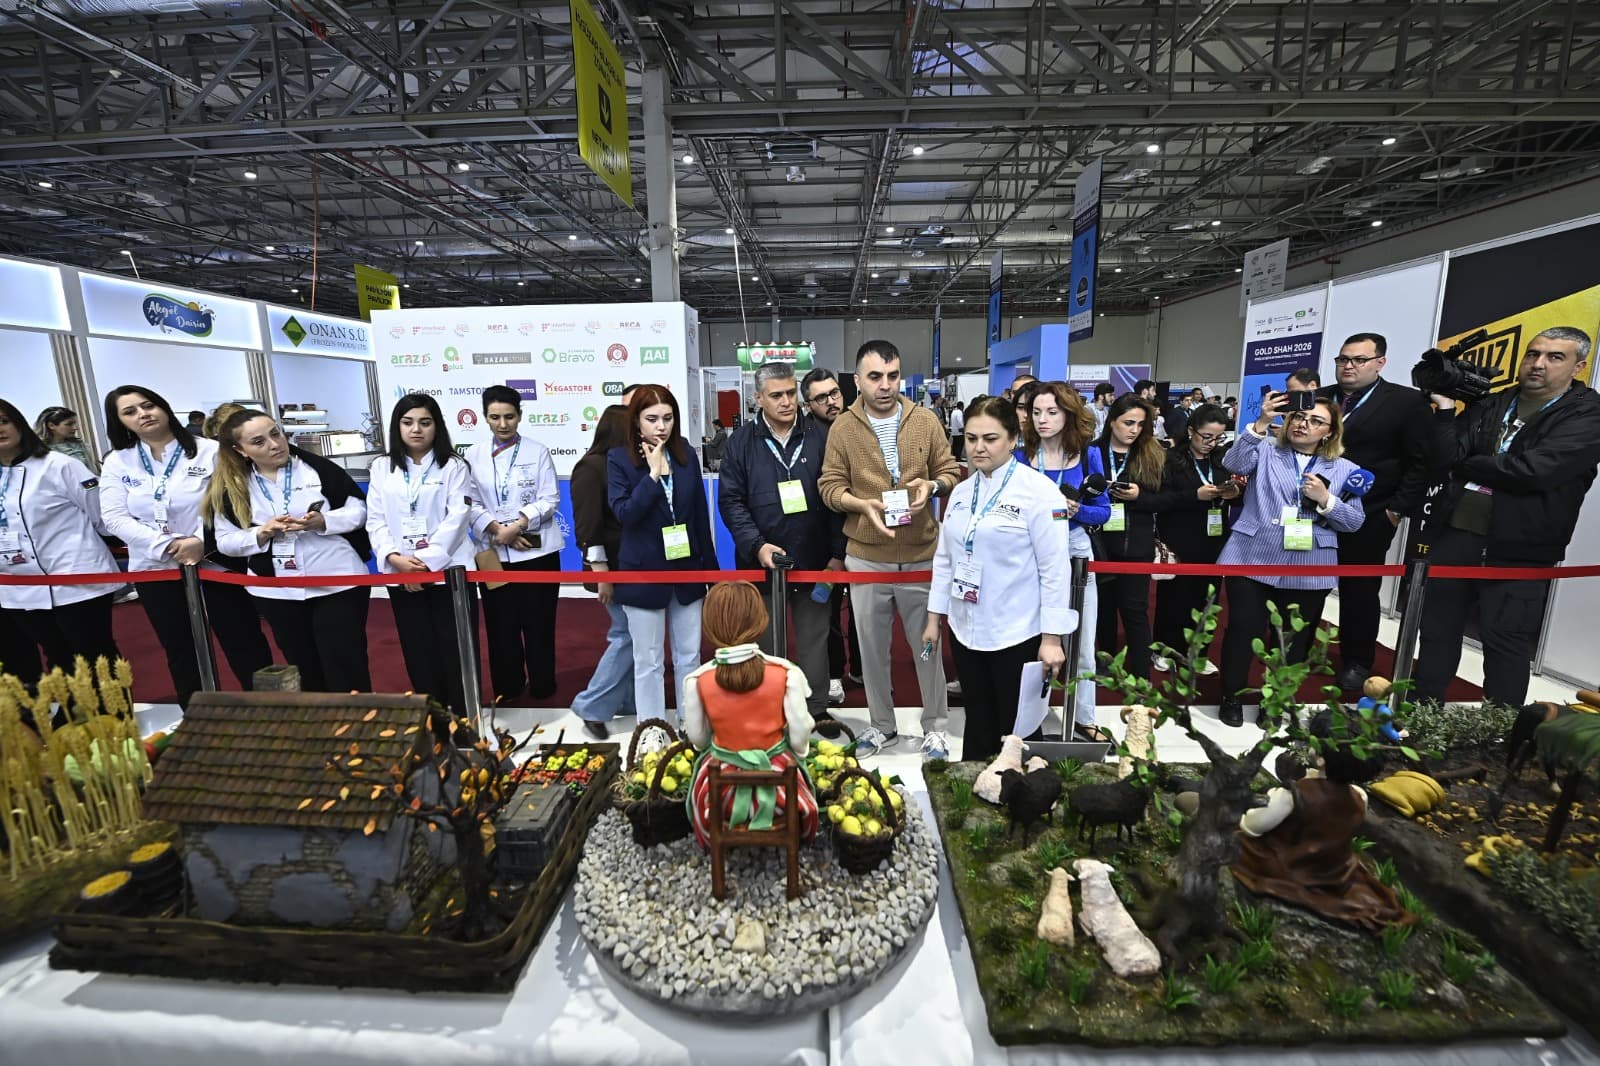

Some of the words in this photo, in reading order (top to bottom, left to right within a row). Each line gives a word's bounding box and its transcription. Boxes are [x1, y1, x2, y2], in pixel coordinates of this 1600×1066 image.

[309, 323, 346, 339] ONAN
[1254, 347, 1272, 356] GOLD
[1273, 344, 1293, 354] SHAH
[1293, 342, 1312, 352] 2026
[390, 354, 420, 364] araz
[559, 352, 595, 363] Bravo
[544, 381, 593, 392] MEGASTORE
[528, 413, 558, 424] araz
[549, 447, 577, 456] aleon
[998, 504, 1020, 515] ACSA
